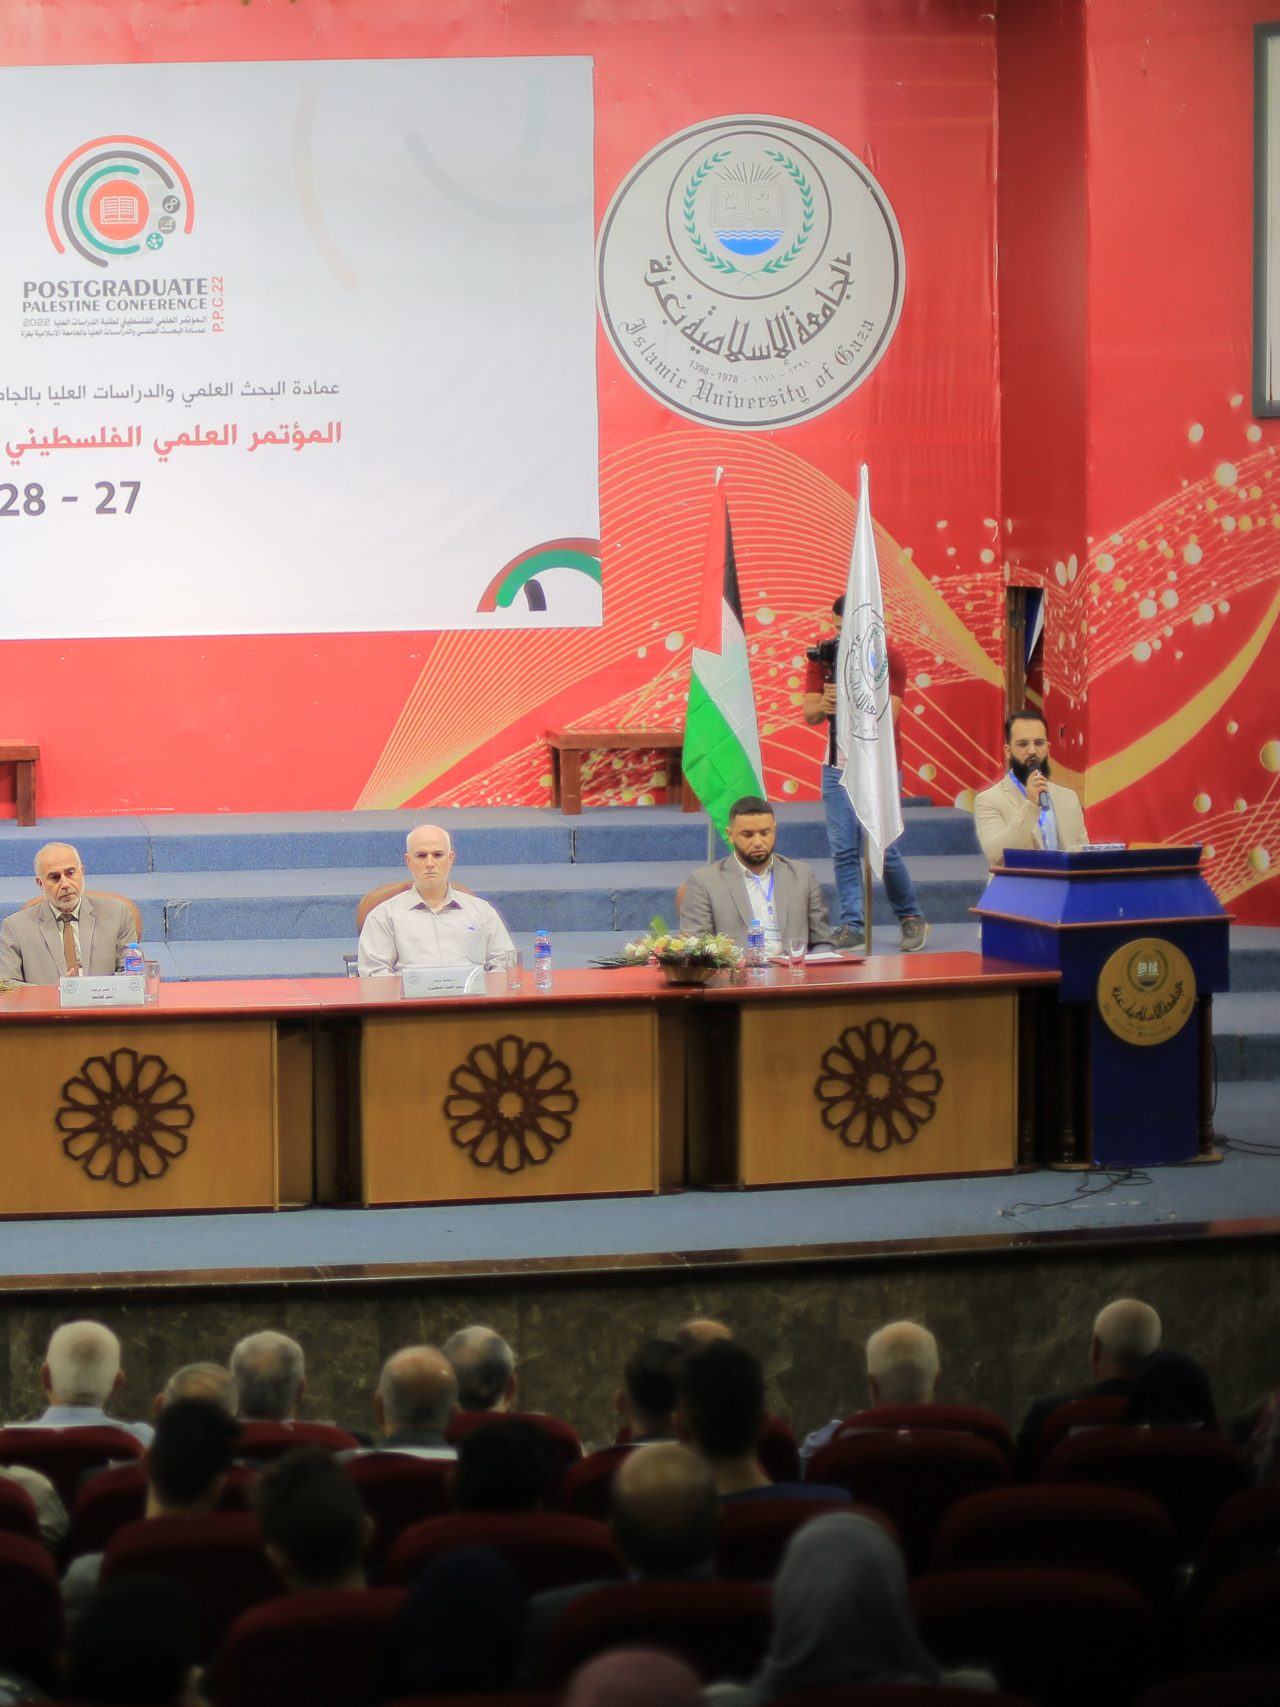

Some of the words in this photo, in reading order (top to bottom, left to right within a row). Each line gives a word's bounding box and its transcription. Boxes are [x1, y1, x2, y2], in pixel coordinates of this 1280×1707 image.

[23, 278, 208, 299] POSTGRADUATE
[22, 300, 100, 313] PALESTINE
[106, 297, 207, 311] CONFERENCE
[212, 276, 224, 333] P.P.C.22
[22, 317, 51, 327] 2022
[618, 318, 688, 390] Islamic
[689, 378, 810, 410] University
[816, 361, 835, 389] of
[689, 359, 710, 376] 1398
[718, 370, 739, 383] 1978
[48, 385, 85, 405] العليا
[94, 384, 174, 403] والدراسات
[182, 382, 233, 407] العلمي
[241, 381, 285, 400] البحث
[293, 381, 339, 394] عمادة
[5, 425, 141, 465] الفلسطيني
[153, 424, 237, 462] العلمي
[247, 421, 341, 452] المؤتمر
[95, 481, 141, 514] 27
